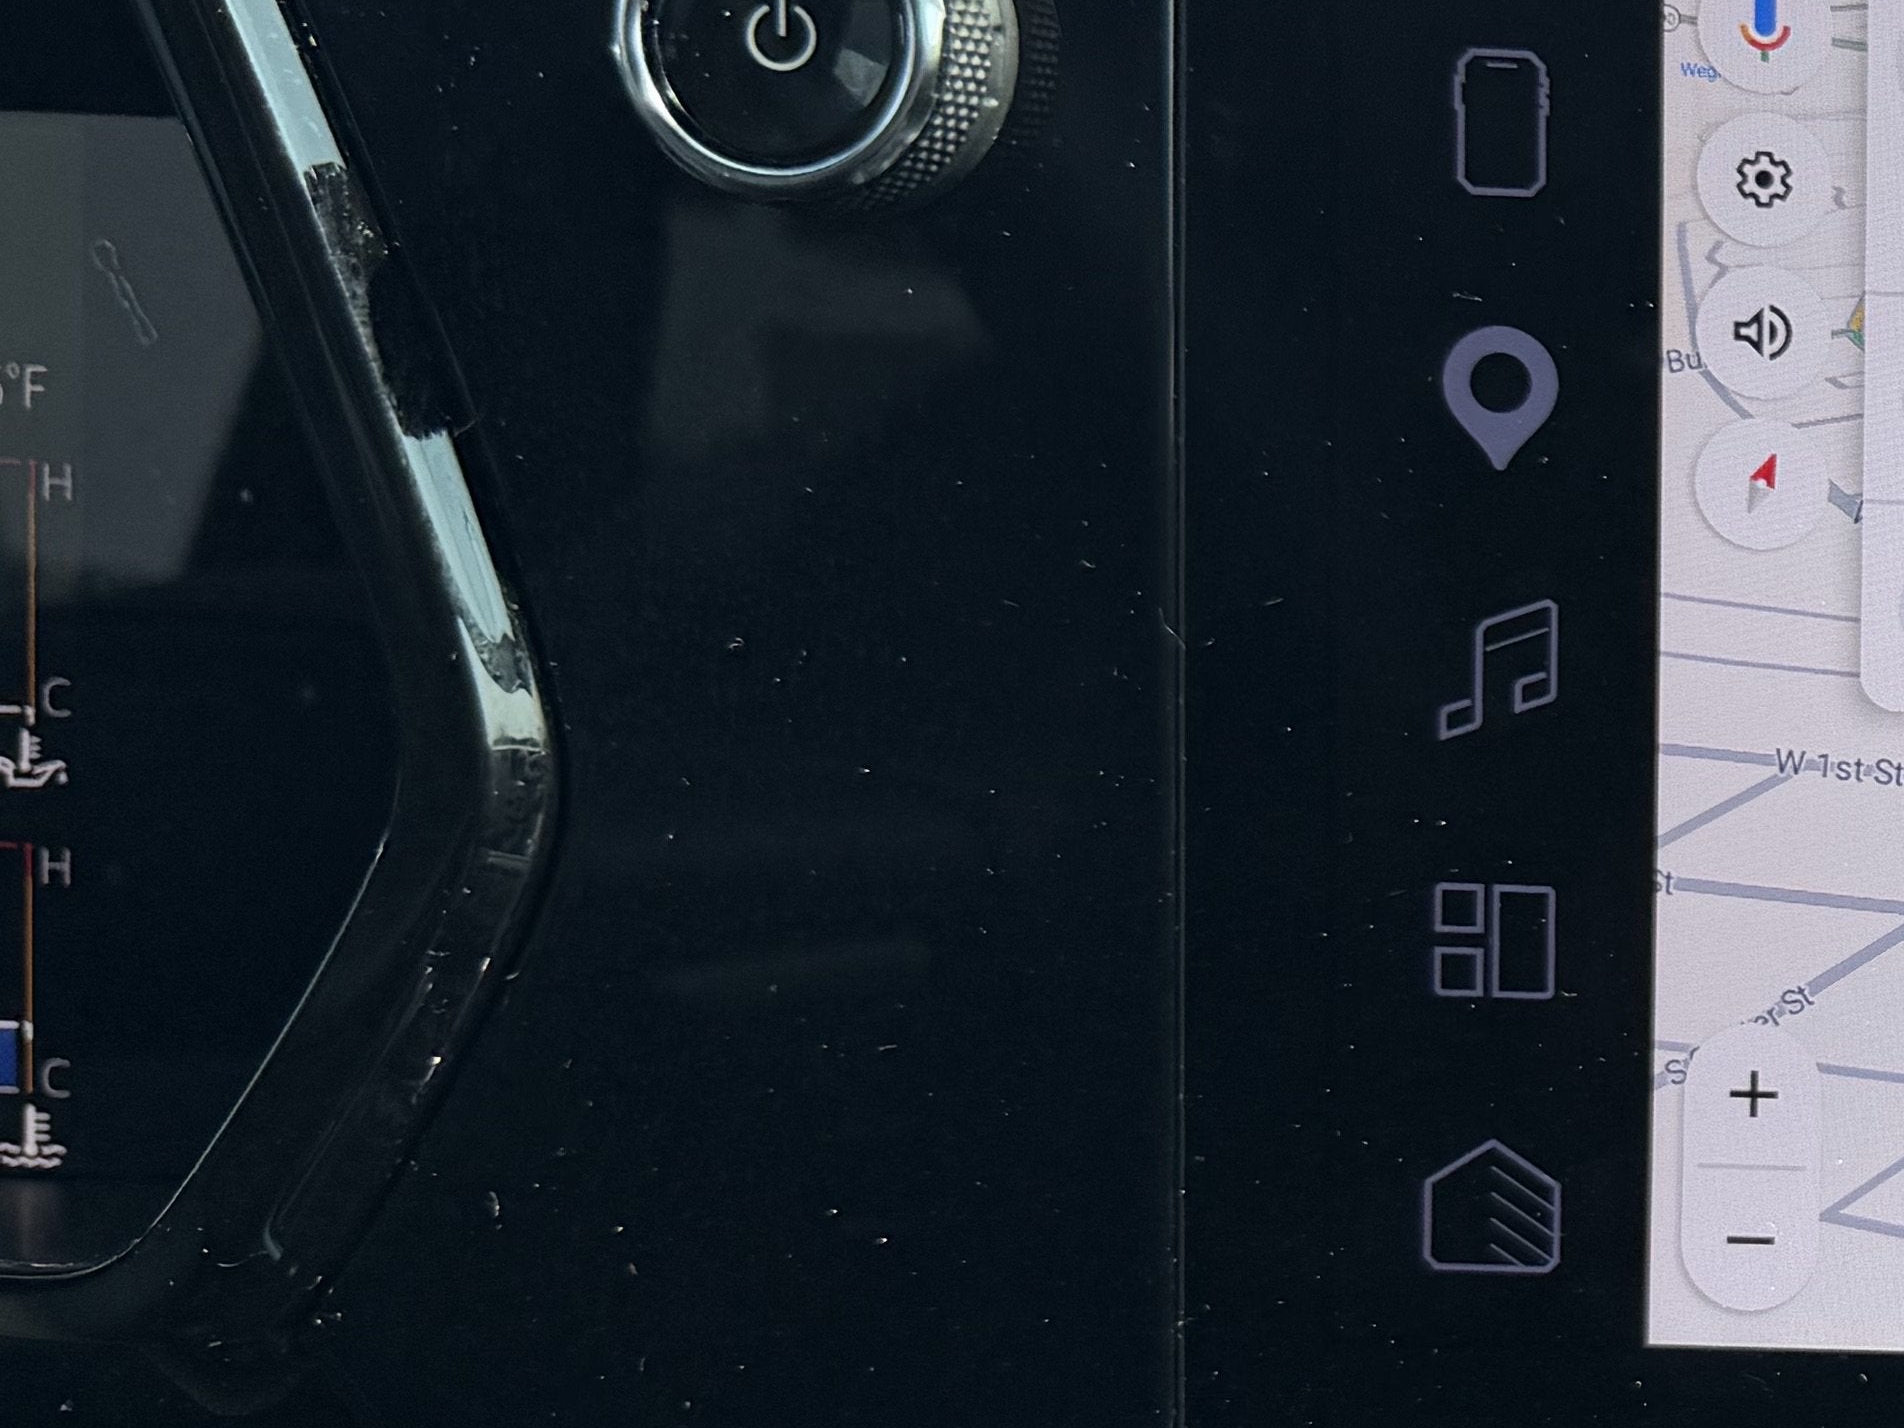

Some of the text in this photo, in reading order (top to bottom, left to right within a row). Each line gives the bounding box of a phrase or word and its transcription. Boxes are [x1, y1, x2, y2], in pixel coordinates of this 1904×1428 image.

[43, 462, 73, 502] H
[42, 675, 72, 719] C
[1775, 748, 1904, 787] W 1st St
[40, 846, 71, 888] H
[1780, 985, 1814, 1015] St
[42, 1057, 71, 1099] C
